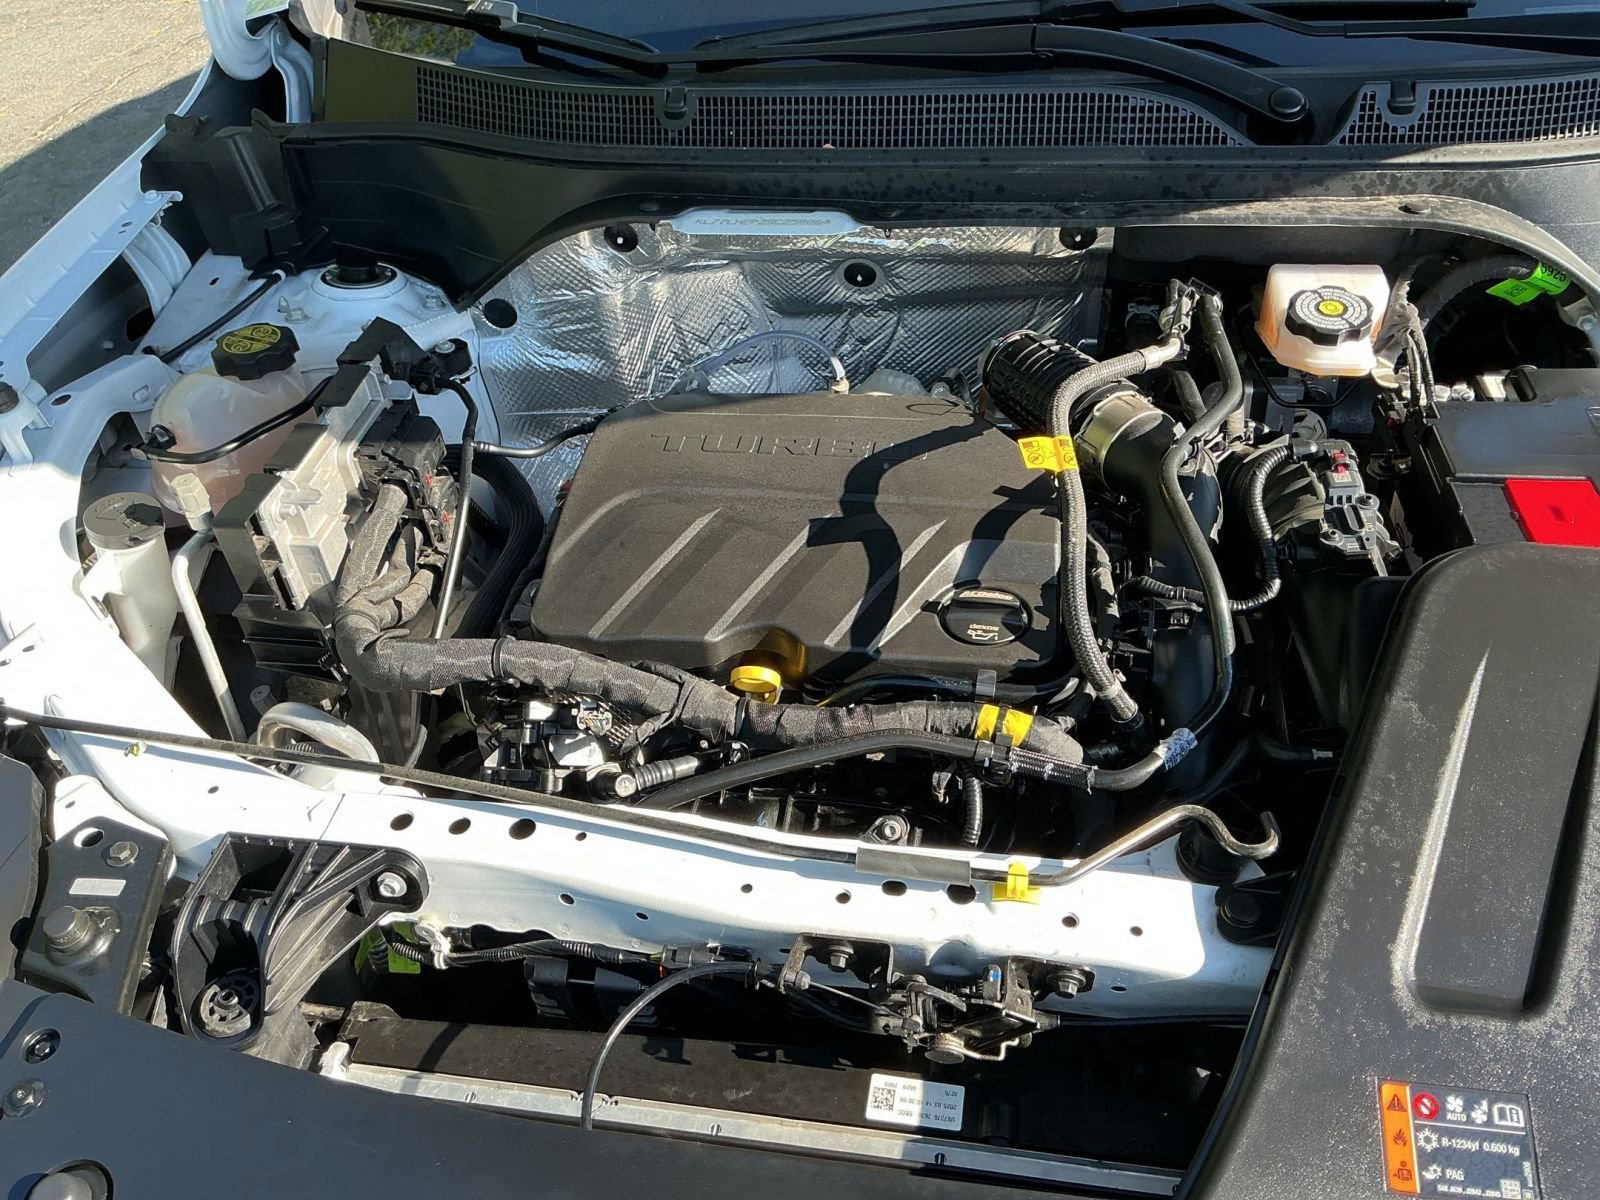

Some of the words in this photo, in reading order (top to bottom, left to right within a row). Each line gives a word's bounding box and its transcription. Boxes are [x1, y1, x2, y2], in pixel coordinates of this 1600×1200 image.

[650, 434, 928, 460] TURBO
[969, 623, 1000, 632] dexos
[1446, 1112, 1467, 1122] AUTO
[1442, 1137, 1480, 1152] R-1234yf
[1483, 1143, 1507, 1153] 0.600
[1508, 1145, 1520, 1156] kg
[1446, 1169, 1465, 1181] PAG
